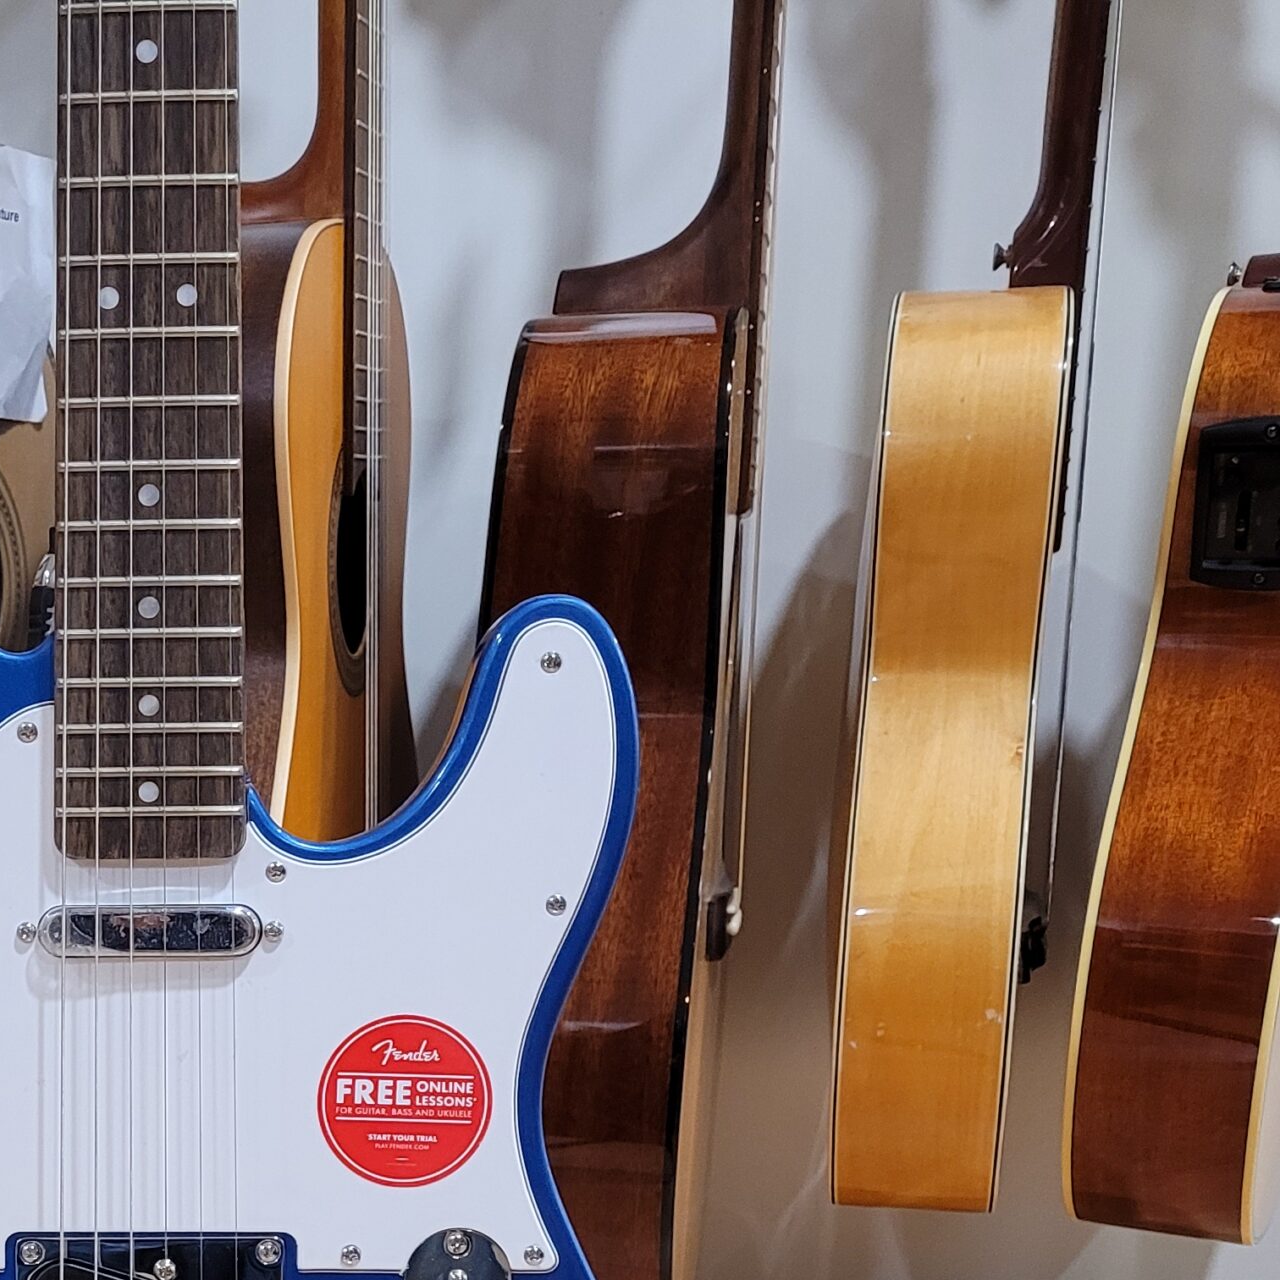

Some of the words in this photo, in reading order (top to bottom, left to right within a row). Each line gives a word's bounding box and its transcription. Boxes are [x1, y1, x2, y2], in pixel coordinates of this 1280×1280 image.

[372, 1039, 441, 1066] Fender
[335, 1078, 412, 1106] FREE
[416, 1080, 475, 1094] ONLINE
[335, 1107, 353, 1115] FOR
[391, 1108, 413, 1116] BASS
[415, 1108, 435, 1117] AND
[437, 1109, 472, 1118] UKULELE
[367, 1133, 391, 1141] START
[392, 1134, 415, 1142] YOUR
[416, 1135, 438, 1143] TRIAL
